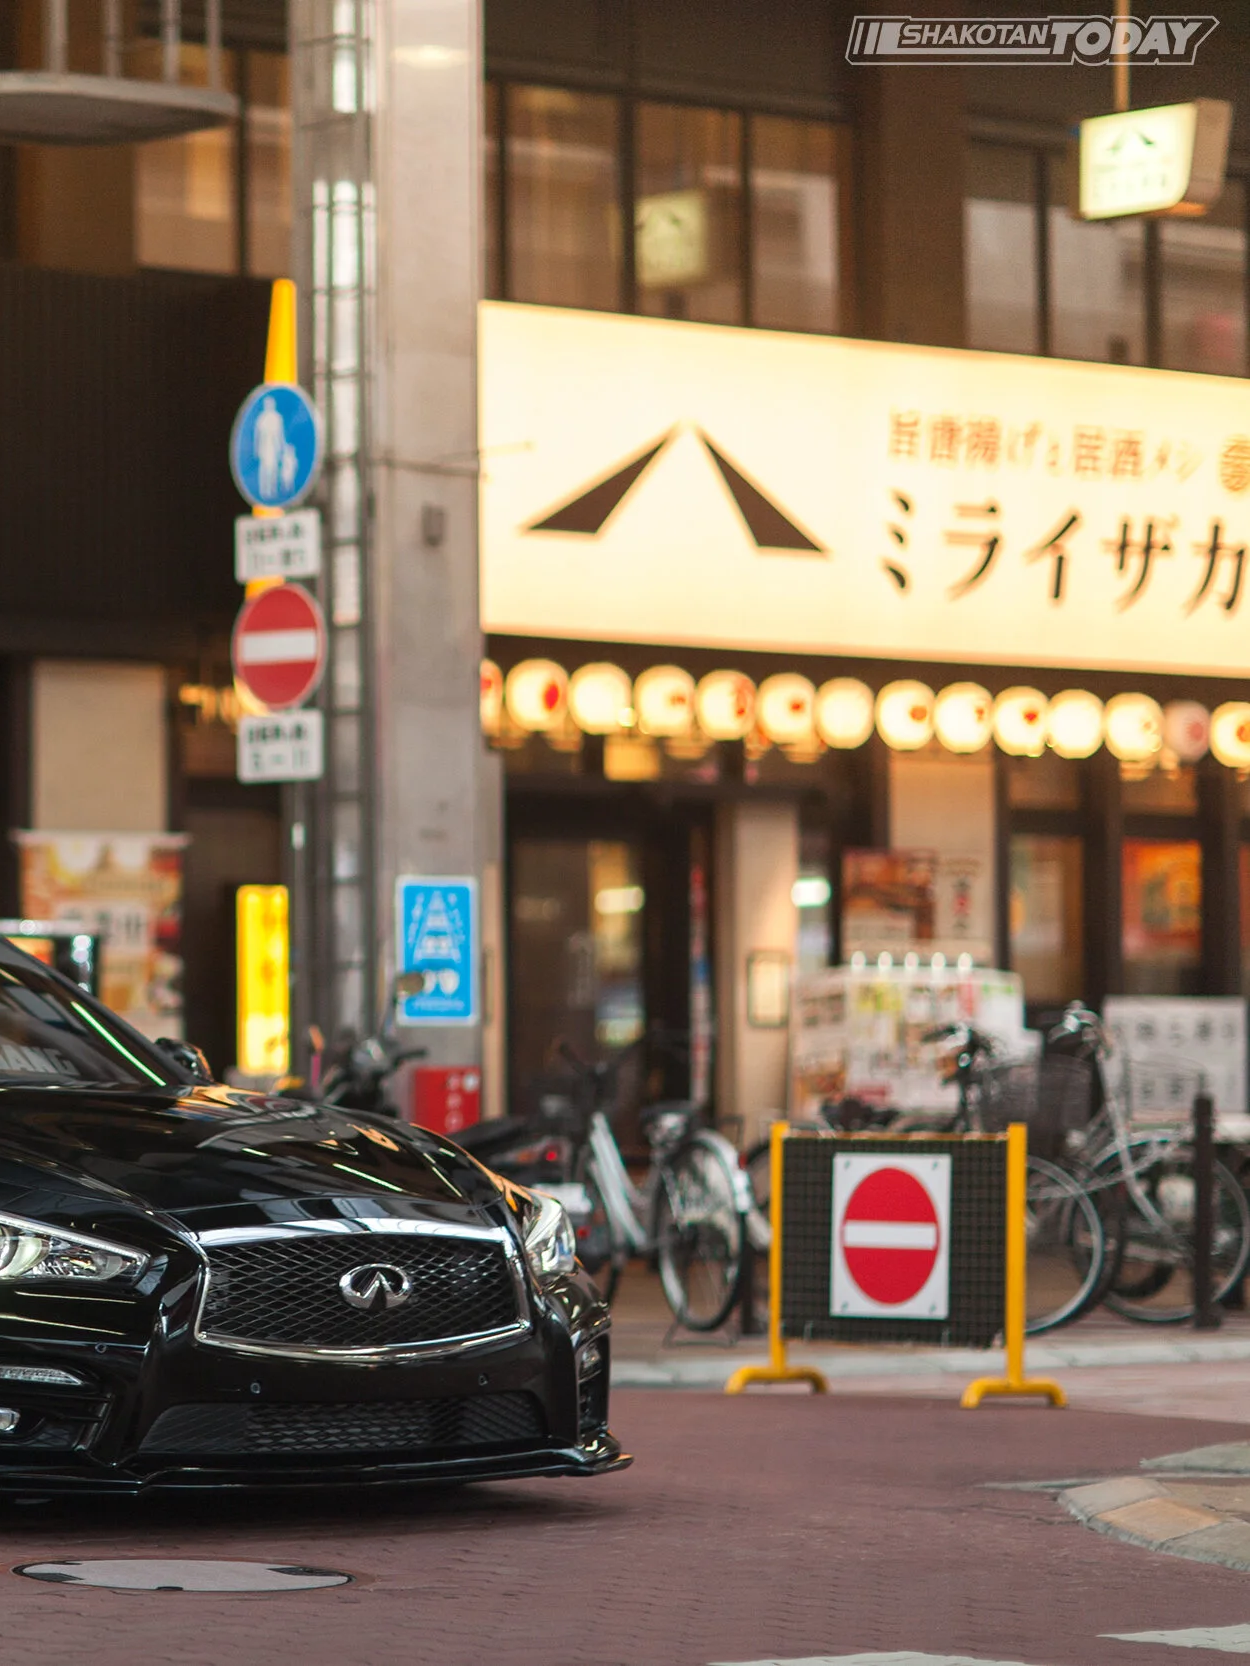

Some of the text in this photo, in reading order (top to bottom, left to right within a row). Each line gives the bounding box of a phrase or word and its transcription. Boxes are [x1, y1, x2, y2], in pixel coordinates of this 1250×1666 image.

[879, 487, 1250, 619] ミライザカ
